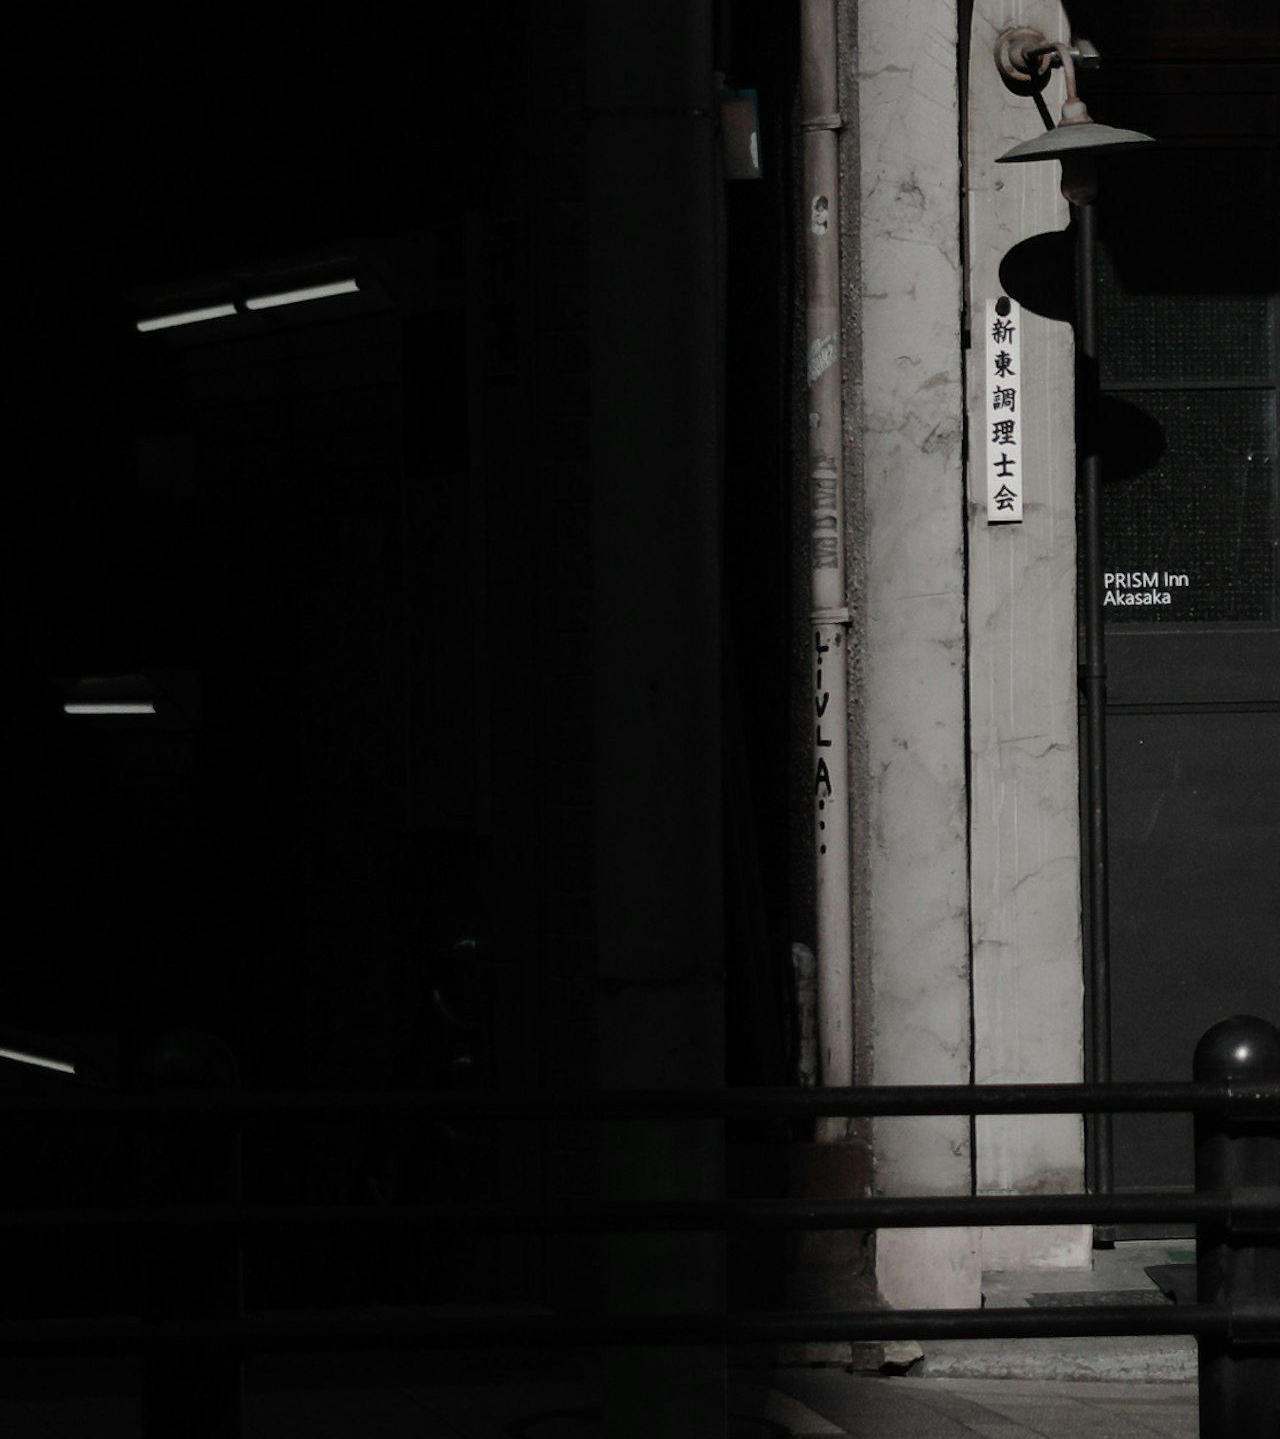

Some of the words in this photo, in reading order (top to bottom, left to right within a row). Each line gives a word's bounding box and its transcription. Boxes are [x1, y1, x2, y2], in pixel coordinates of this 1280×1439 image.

[991, 318, 1019, 512] 新東調理士会
[1103, 571, 1159, 590] PRISM
[1163, 570, 1190, 588] Inn
[1102, 588, 1172, 607] Akasaka
